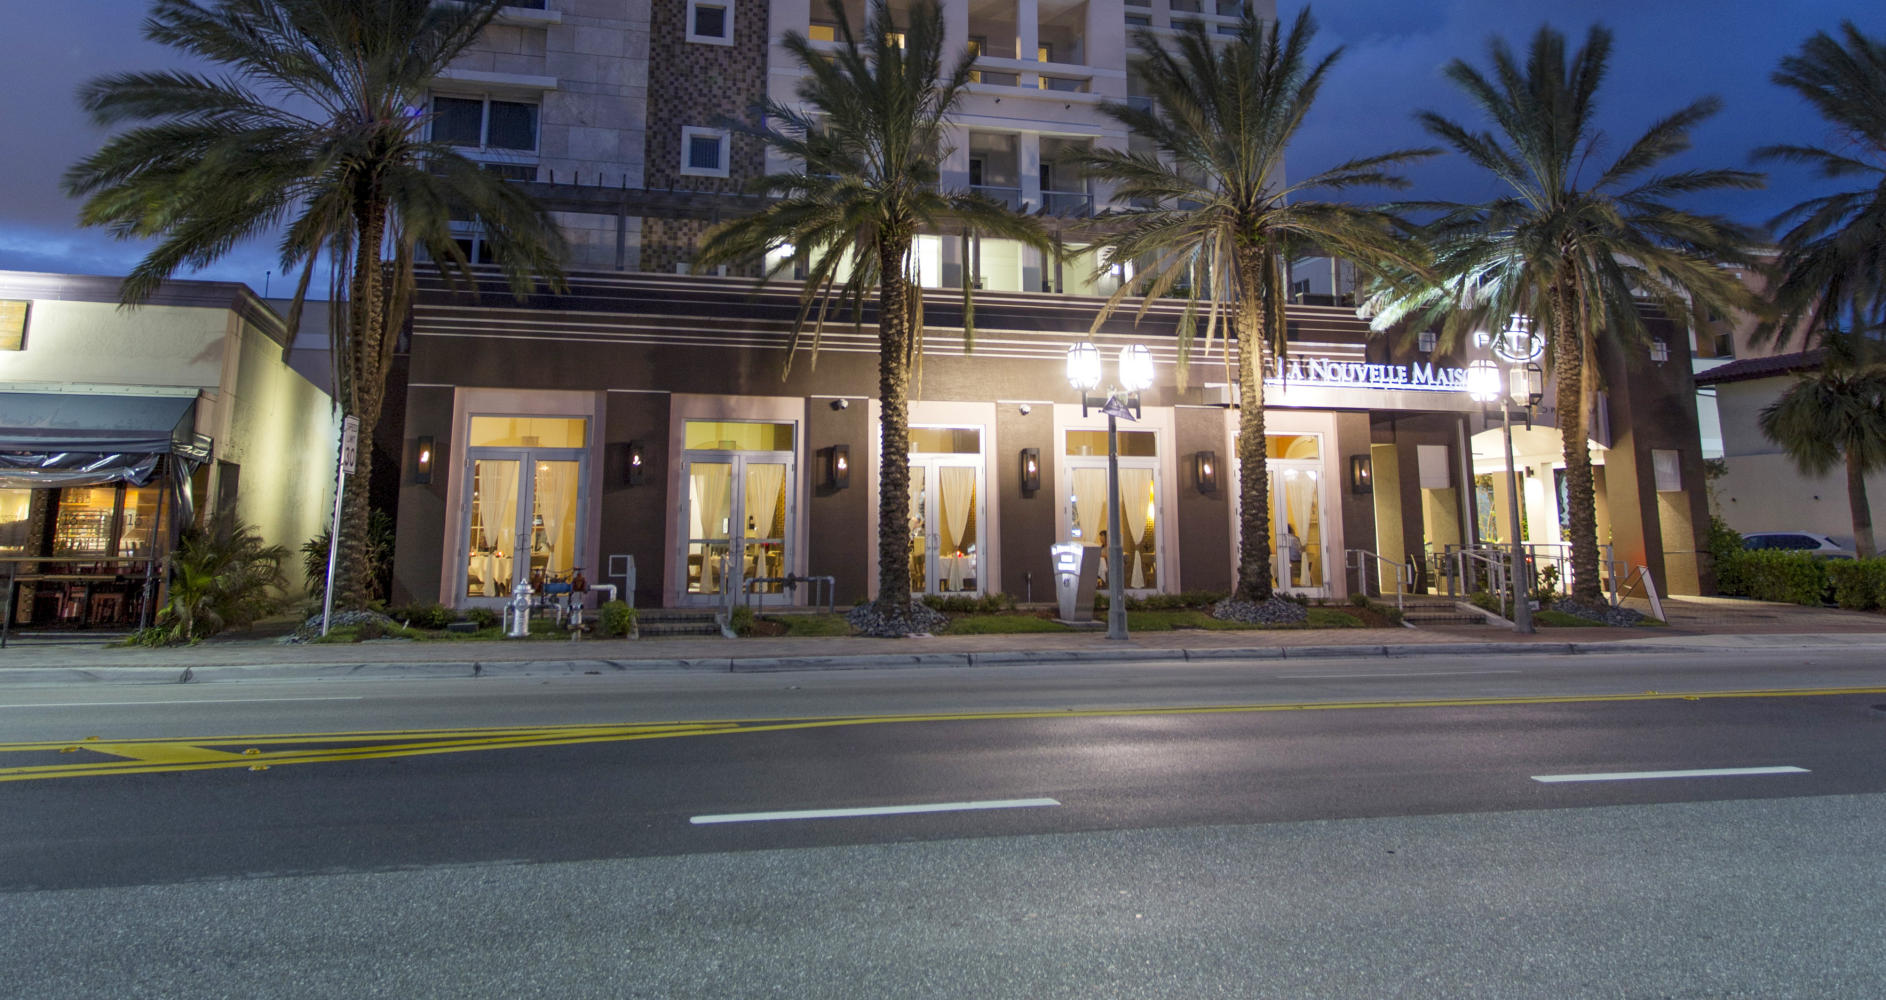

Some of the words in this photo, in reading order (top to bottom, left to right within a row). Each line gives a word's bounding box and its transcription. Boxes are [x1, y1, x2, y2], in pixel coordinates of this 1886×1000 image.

[1277, 357, 1304, 380] LA
[1308, 358, 1408, 383] NOUVELLE
[344, 446, 355, 467] 30
